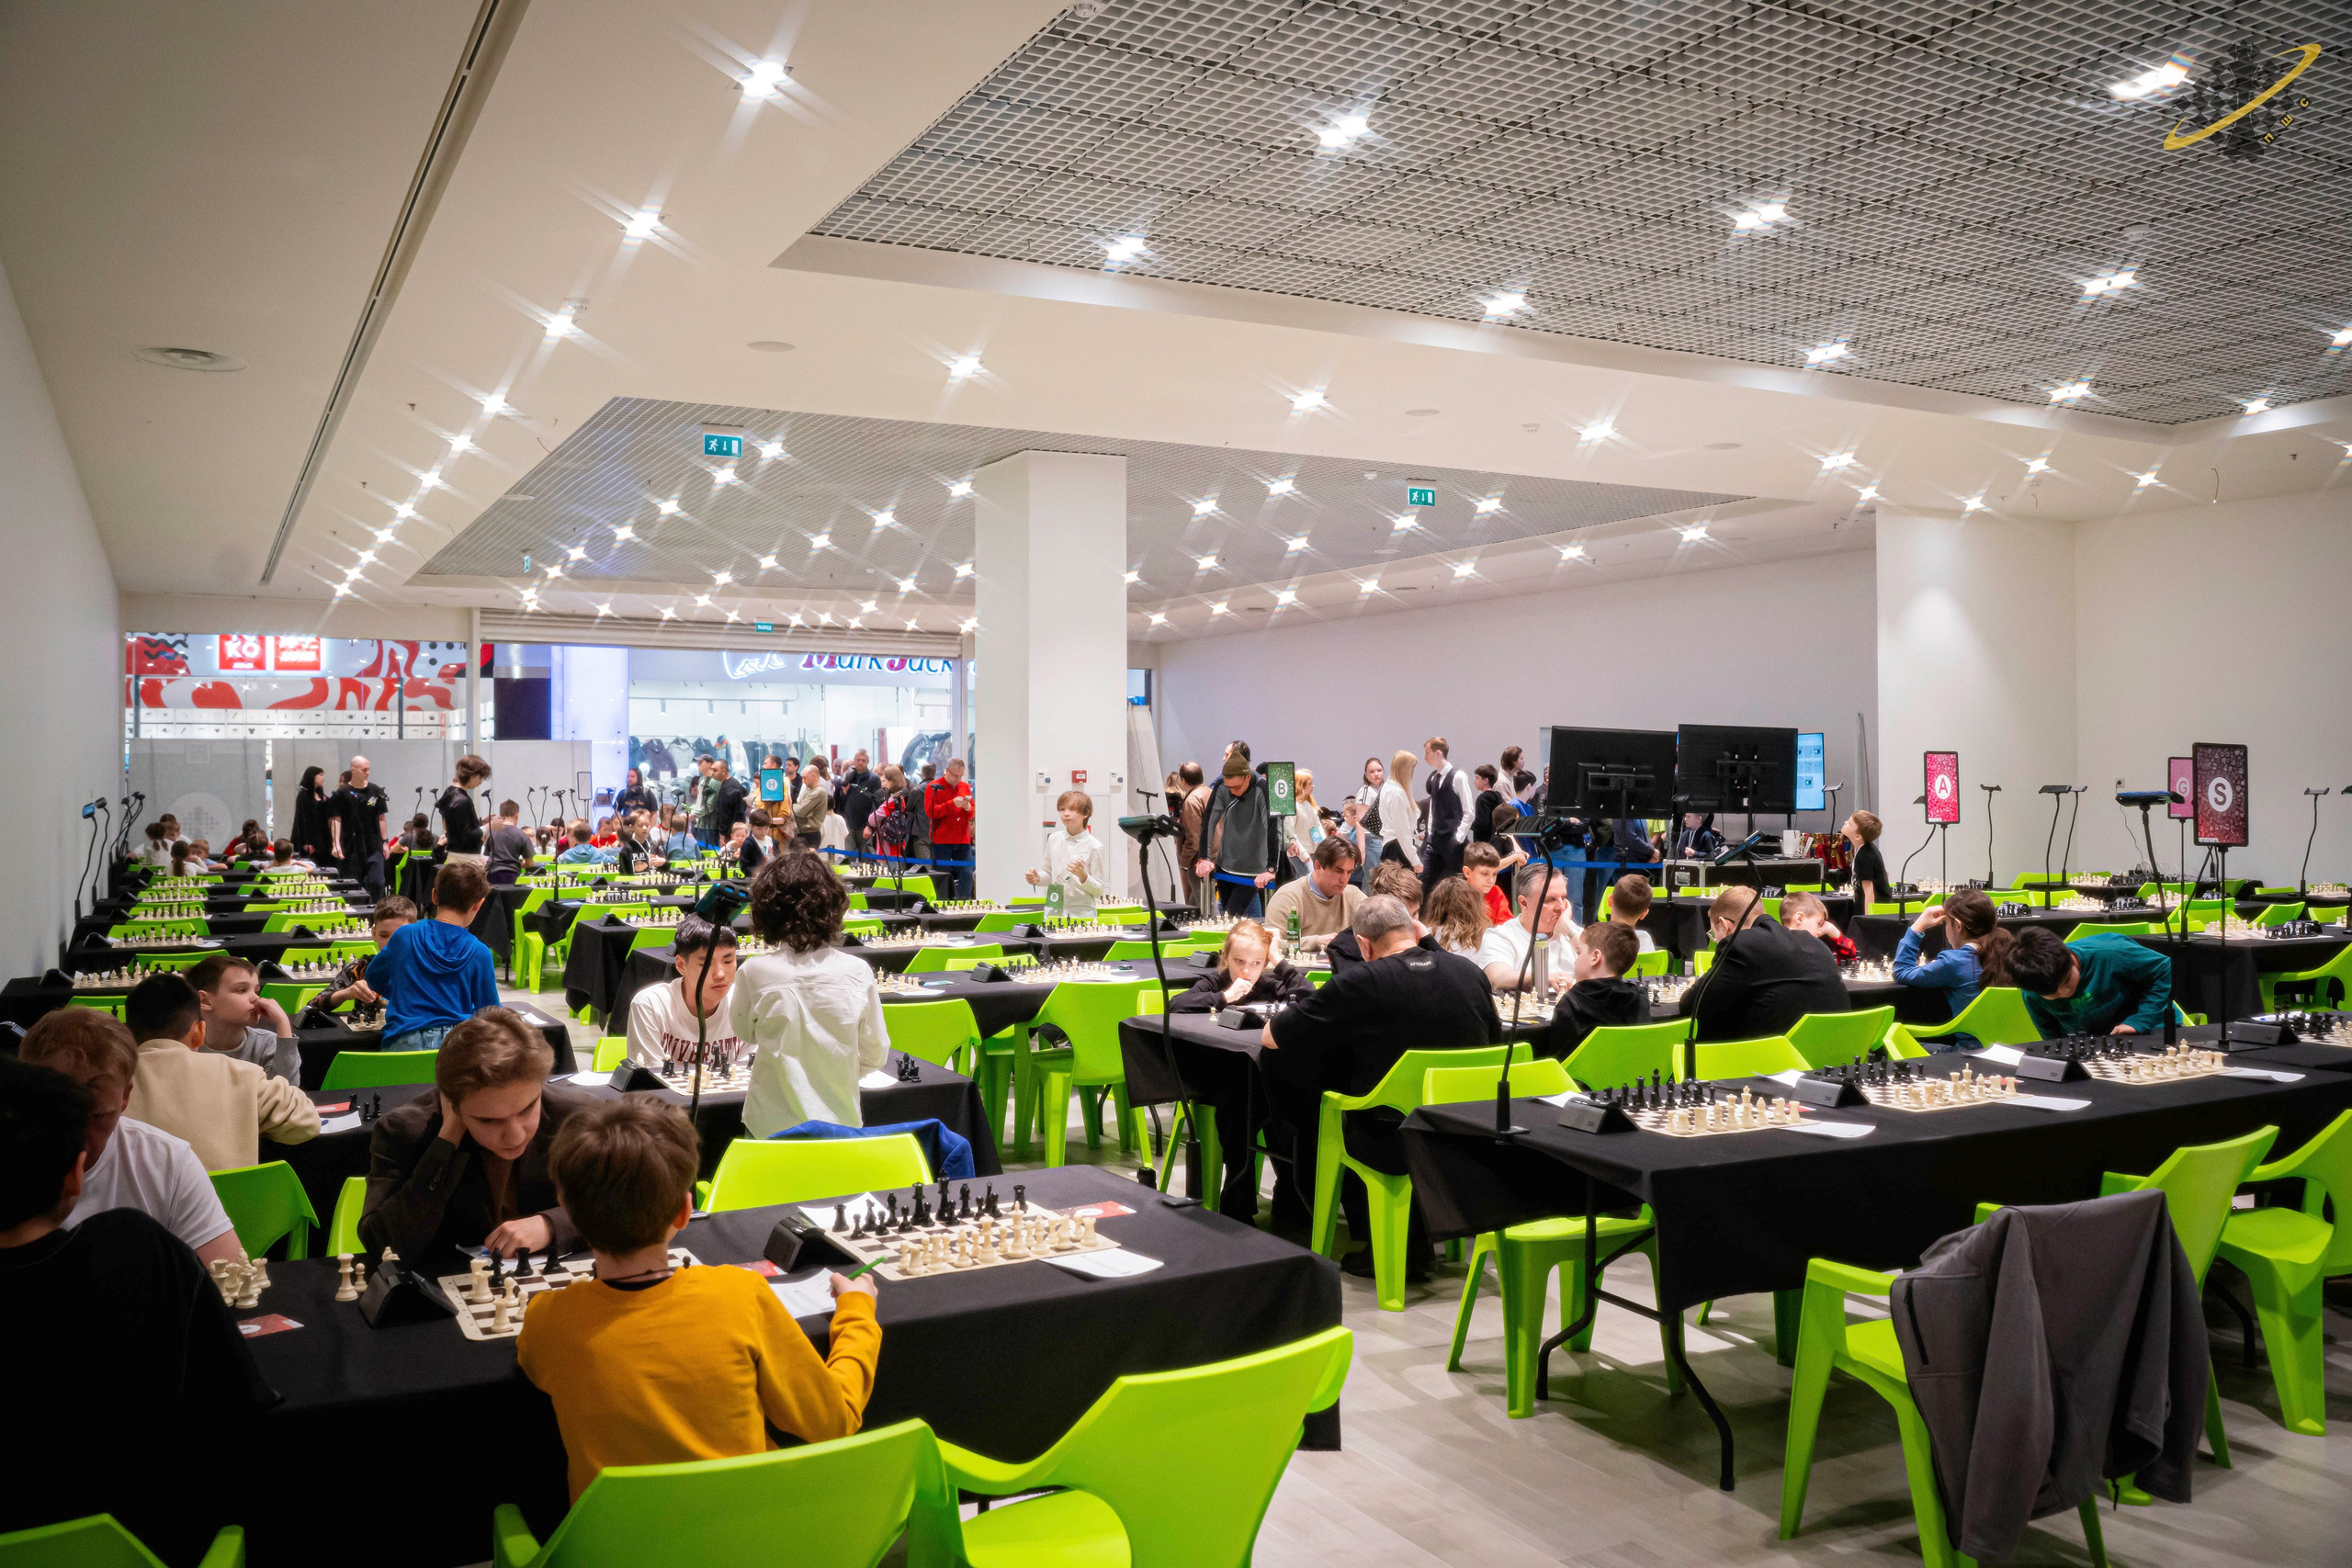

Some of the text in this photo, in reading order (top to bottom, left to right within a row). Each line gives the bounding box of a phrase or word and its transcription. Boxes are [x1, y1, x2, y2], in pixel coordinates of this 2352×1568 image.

[1278, 783, 1286, 795] B
[1939, 777, 1949, 795] A
[2213, 782, 2227, 807] S
[661, 1032, 741, 1065] NIVERSITY
